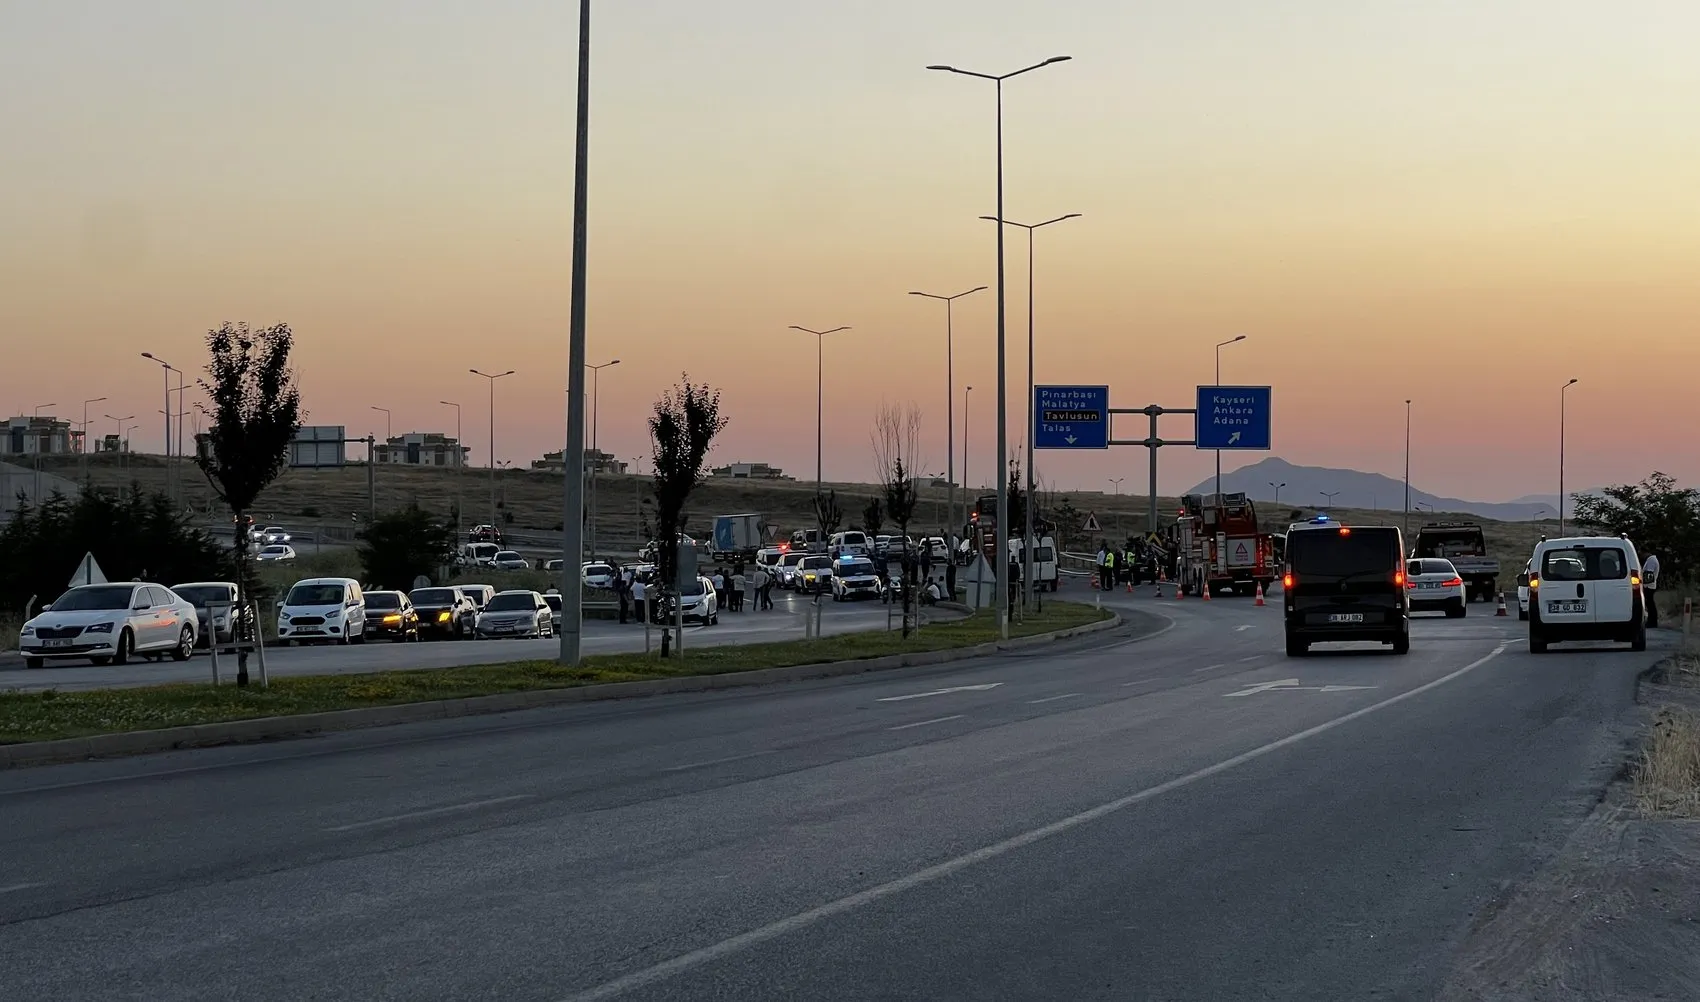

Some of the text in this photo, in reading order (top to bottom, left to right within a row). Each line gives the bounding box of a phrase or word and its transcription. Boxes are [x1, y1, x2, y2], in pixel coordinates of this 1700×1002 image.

[1042, 390, 1096, 399] Pınarbaşı
[1042, 400, 1086, 409] Malatya
[1213, 395, 1254, 406] Kayseri
[1213, 406, 1253, 414] Ankara
[1045, 411, 1097, 420] Tavlusun
[1213, 416, 1249, 425] Adana
[1042, 424, 1071, 432] Talas
